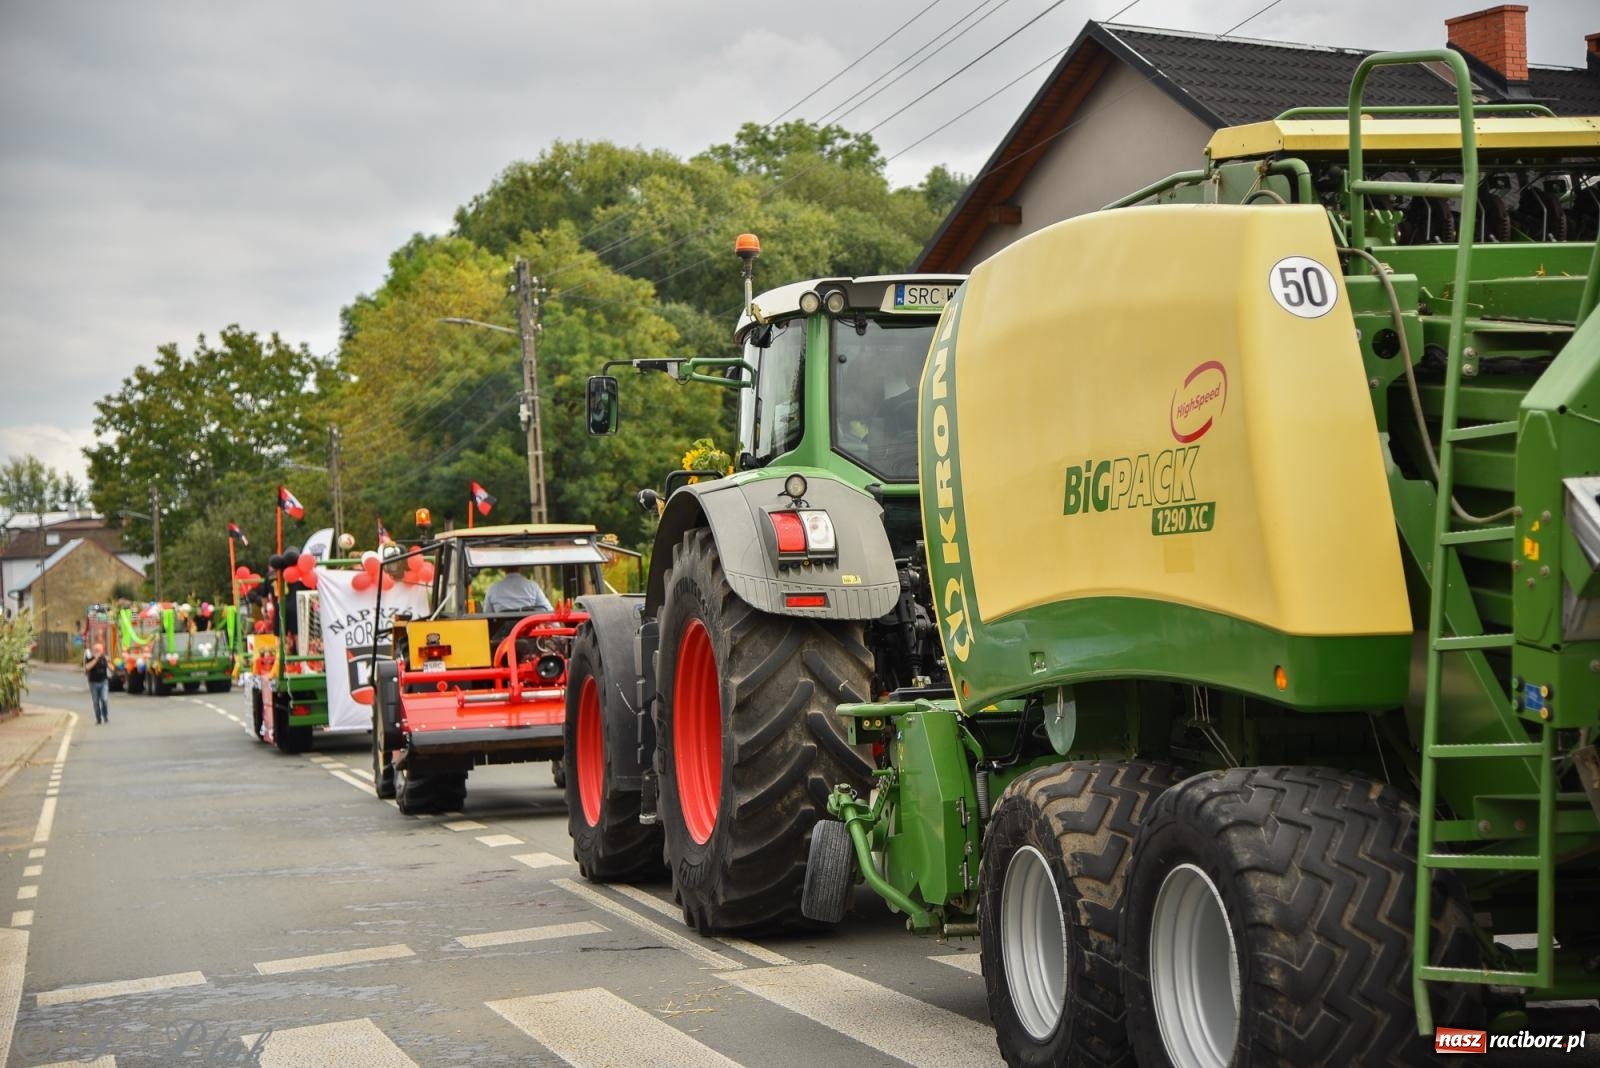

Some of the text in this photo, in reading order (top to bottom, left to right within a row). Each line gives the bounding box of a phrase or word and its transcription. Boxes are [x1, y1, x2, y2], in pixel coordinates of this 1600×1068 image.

[908, 287, 940, 304] SRC
[1279, 266, 1328, 307] 50
[1177, 382, 1222, 419] HighSpeed
[1157, 505, 1209, 533] 1290 XC
[328, 606, 423, 635] NAPRZÓ
